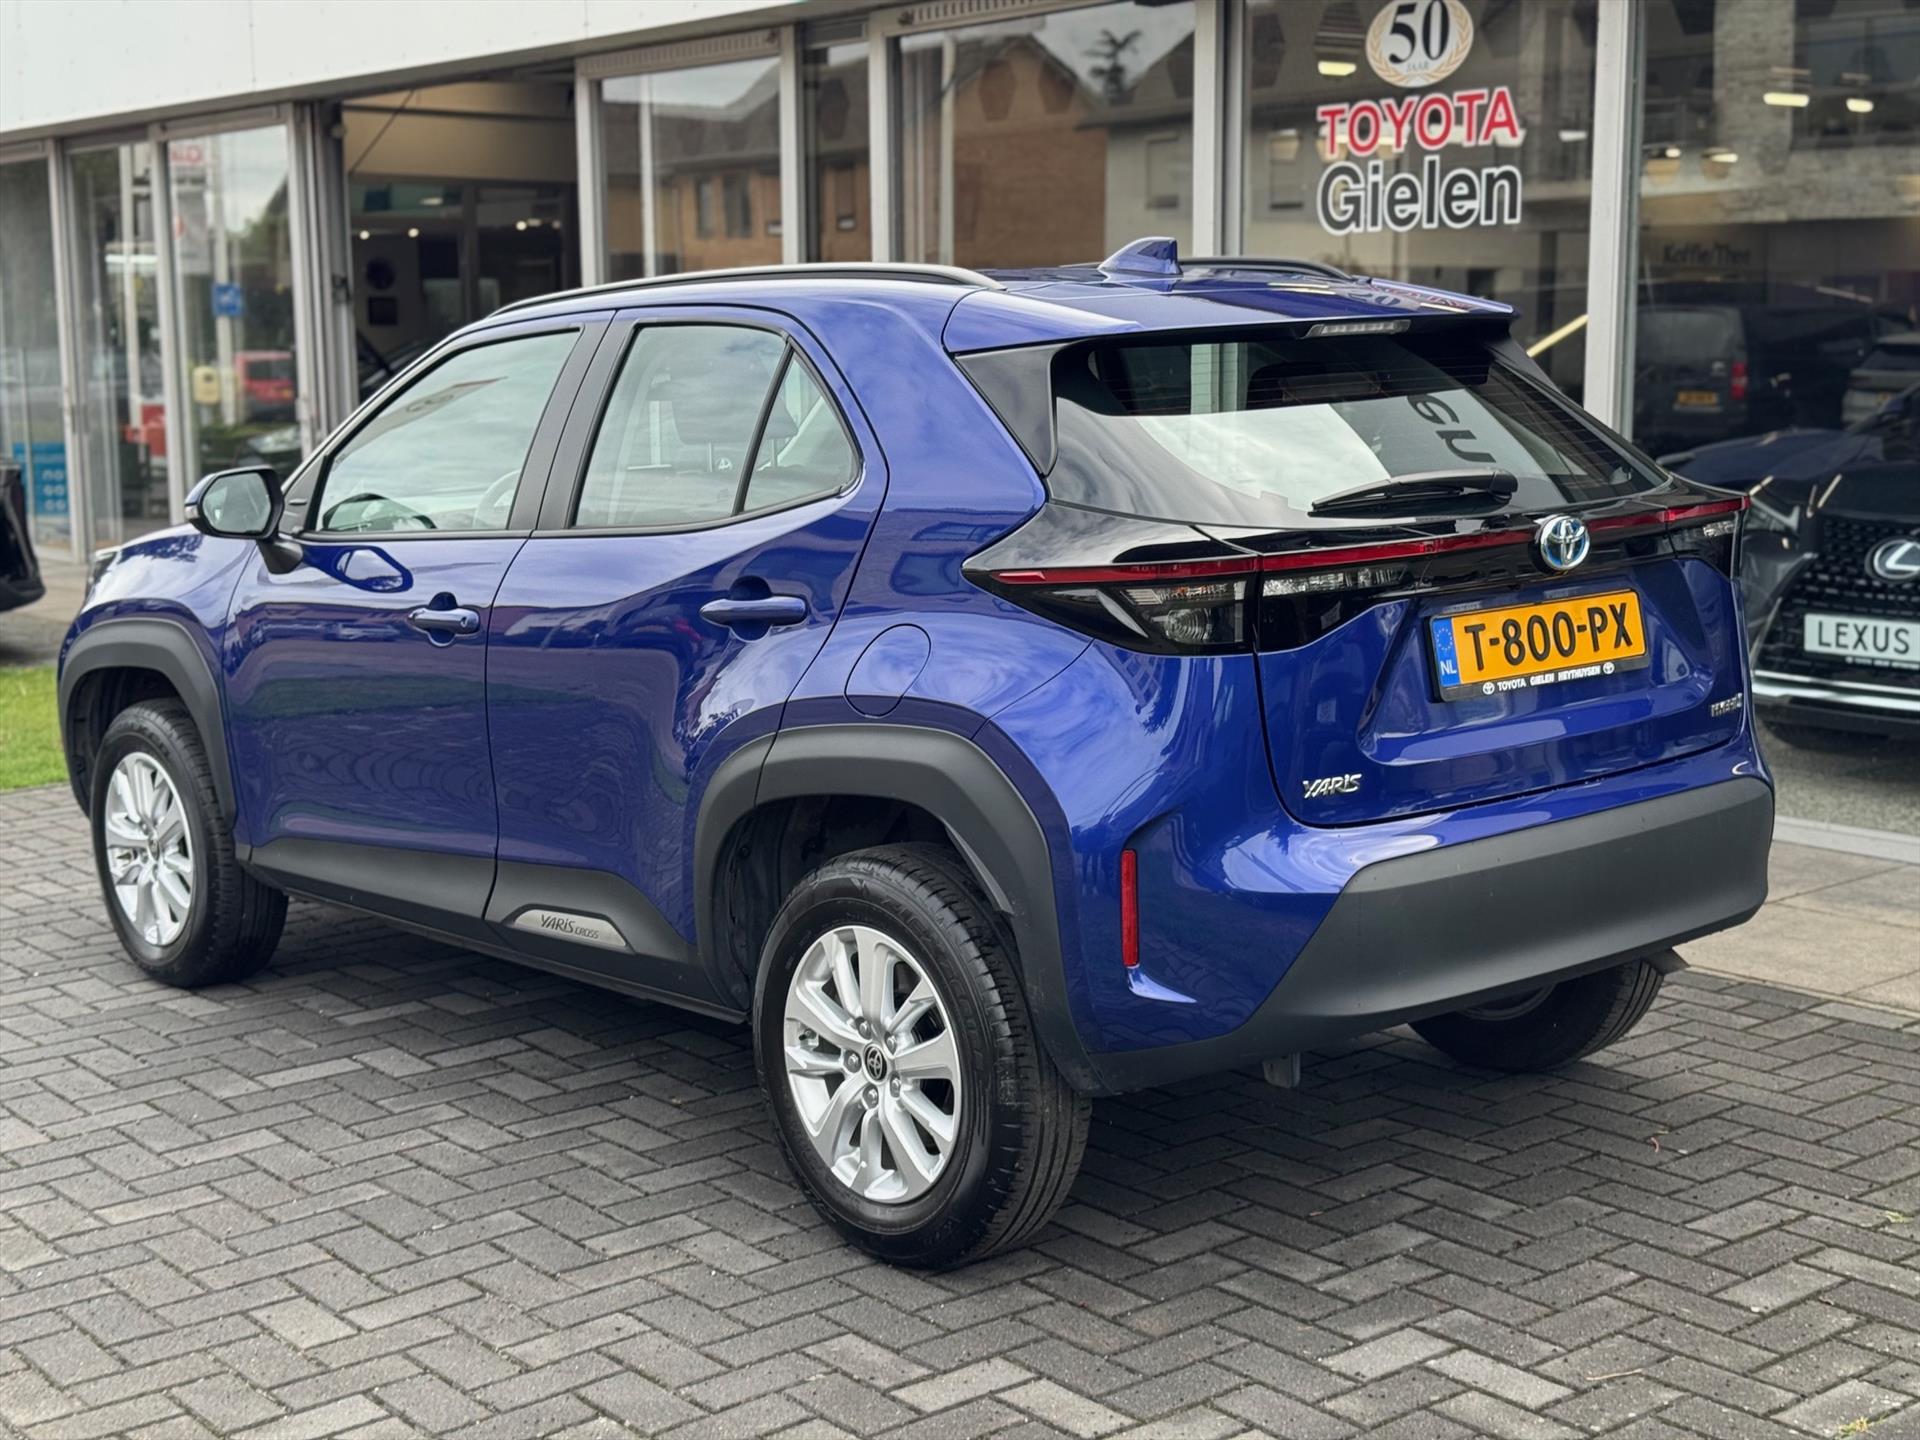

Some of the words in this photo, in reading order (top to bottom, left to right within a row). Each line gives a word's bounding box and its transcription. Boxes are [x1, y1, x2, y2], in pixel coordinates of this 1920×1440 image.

[1389, 0, 1450, 64] 50
[1317, 87, 1519, 156] TOYOTA
[1317, 155, 1521, 235] Gielen
[1464, 602, 1633, 671] T-800-PX
[1818, 620, 1910, 655] LEXUS
[1440, 659, 1457, 675] NL
[1497, 678, 1527, 691] TOYOTA
[1529, 673, 1555, 686] GIELEN
[574, 926, 600, 940] CROSS
